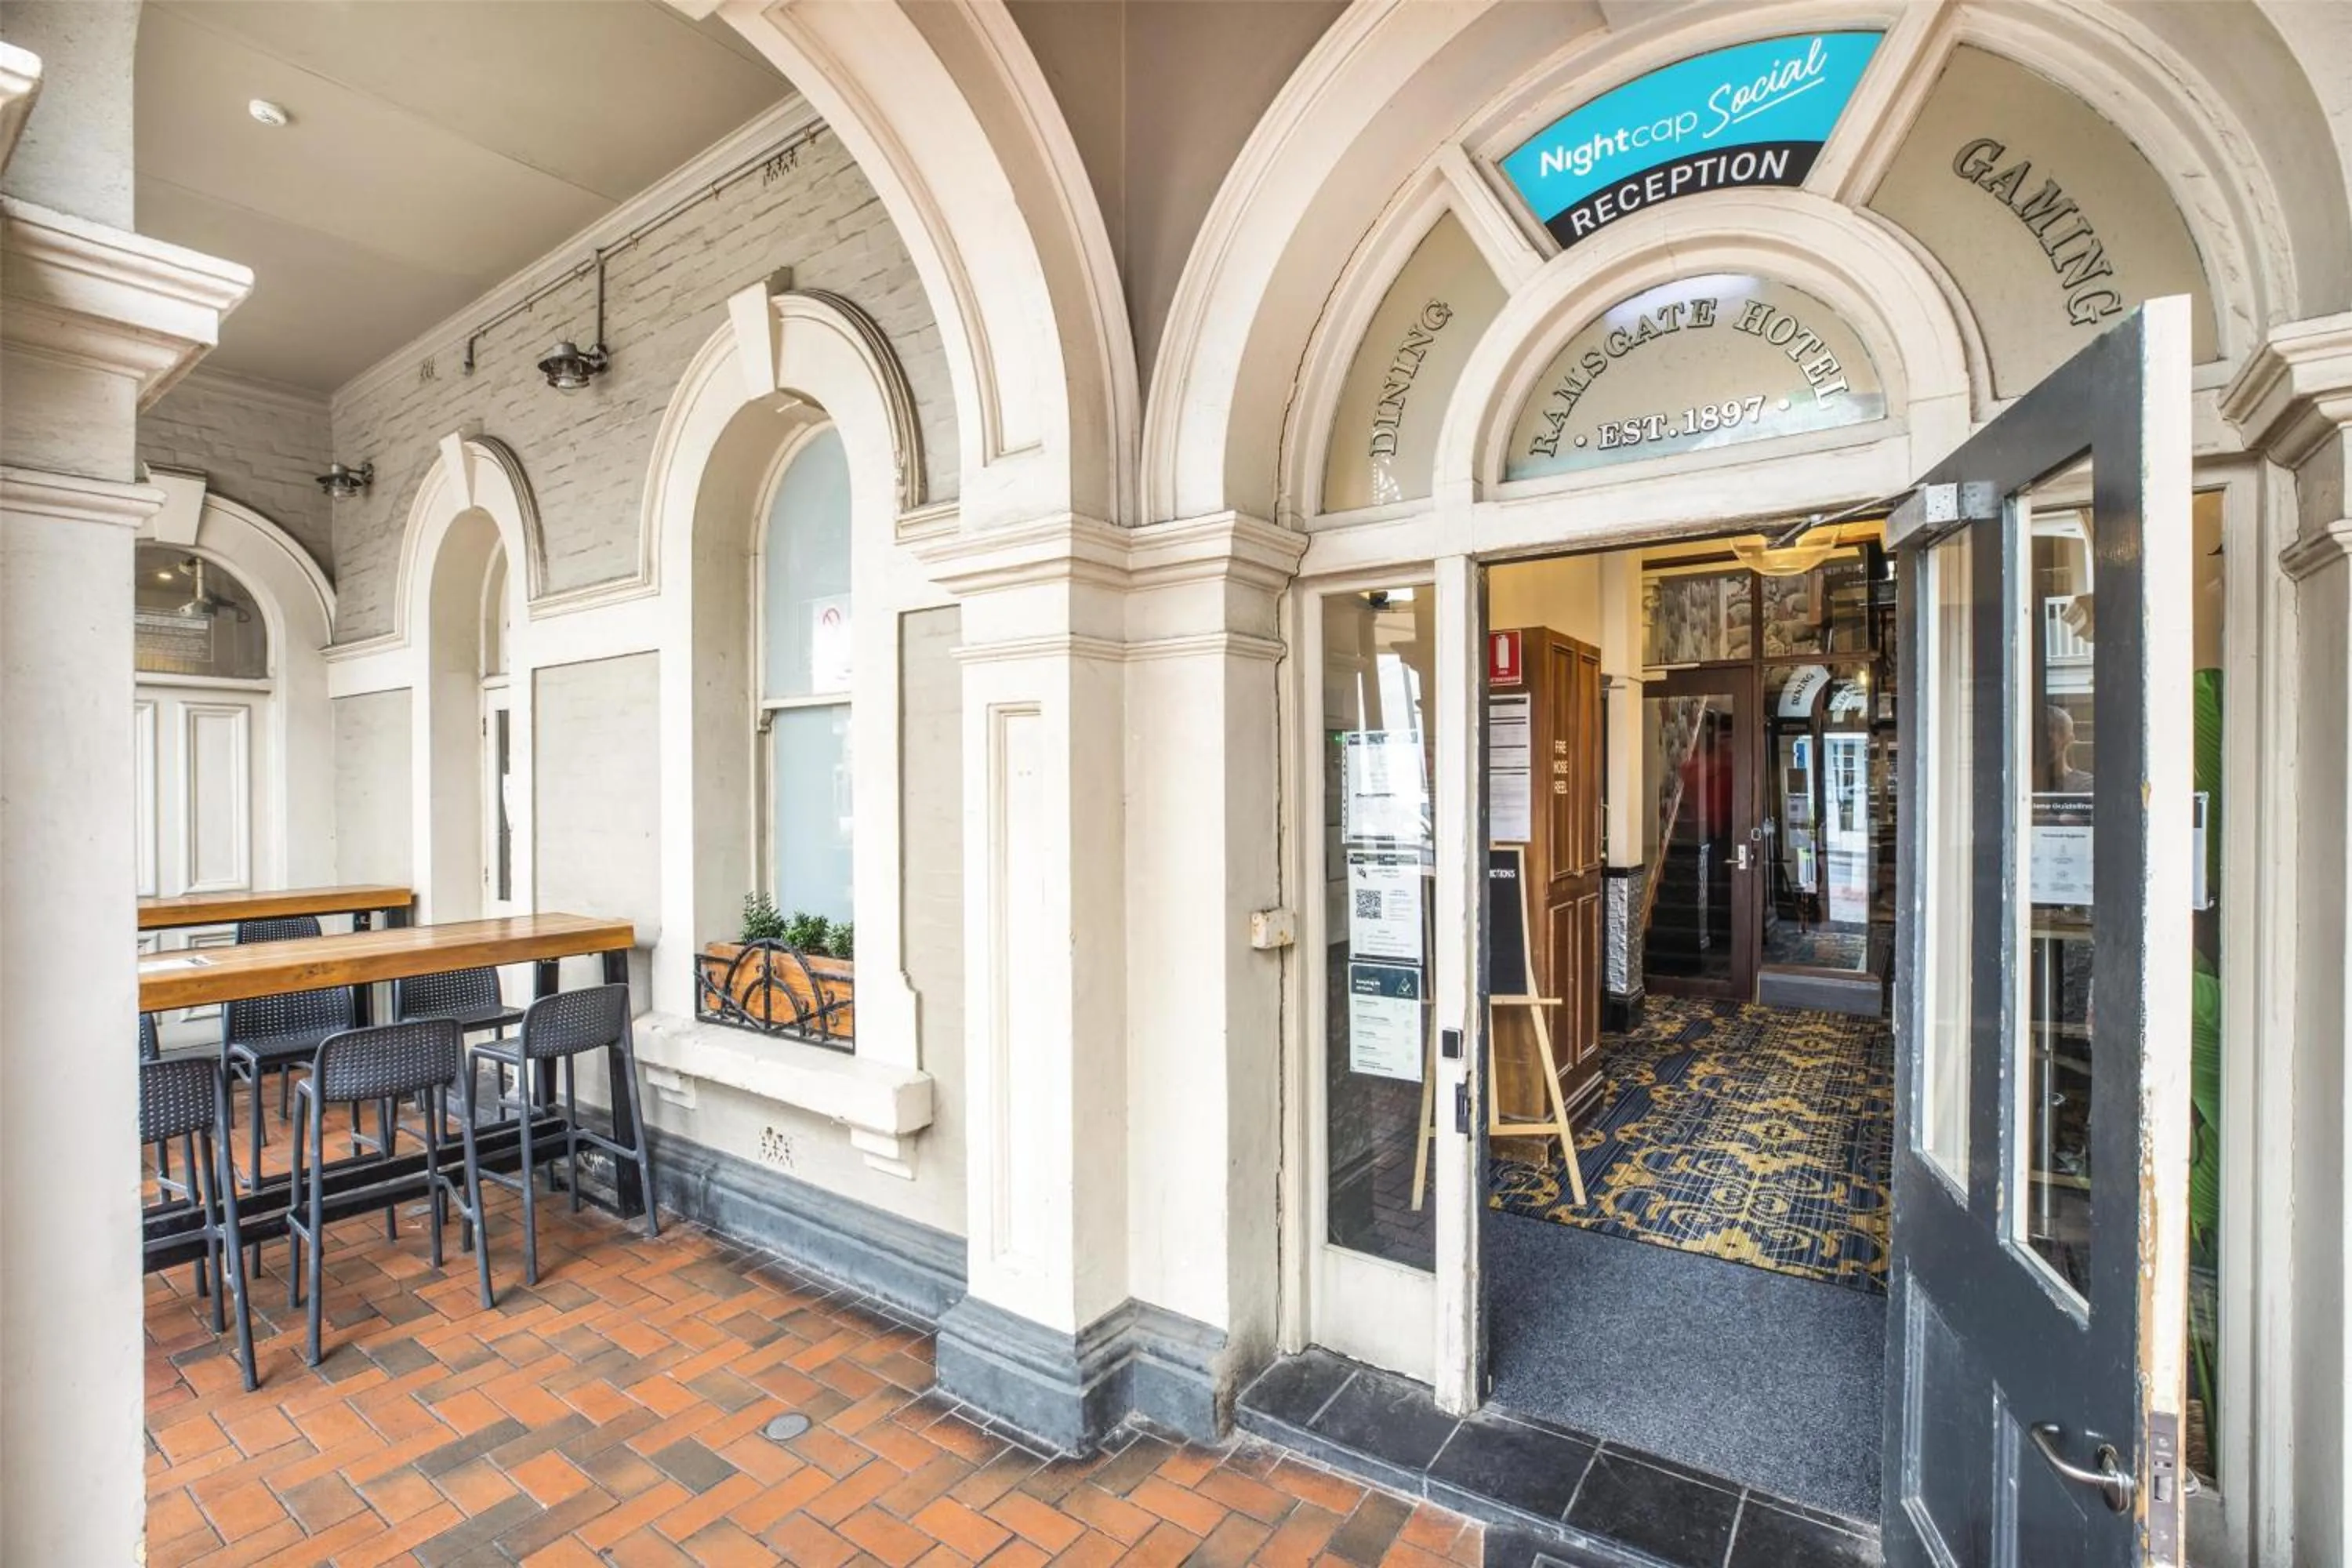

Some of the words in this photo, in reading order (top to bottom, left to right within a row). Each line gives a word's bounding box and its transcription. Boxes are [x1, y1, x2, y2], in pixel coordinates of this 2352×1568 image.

[1540, 108, 1698, 178] Nightcap
[1702, 37, 1828, 139] Social
[1570, 149, 1790, 237] RECEPTION
[1952, 137, 2123, 327] GAMING
[1369, 299, 1454, 458] DINING
[1528, 297, 1719, 458] RAMSGATE
[1732, 298, 1850, 411] HOTEL
[1791, 673, 1816, 706] DINING
[1553, 760, 1568, 774] HOSE
[1555, 739, 1567, 755] FIRE
[1555, 780, 1568, 794] REEL
